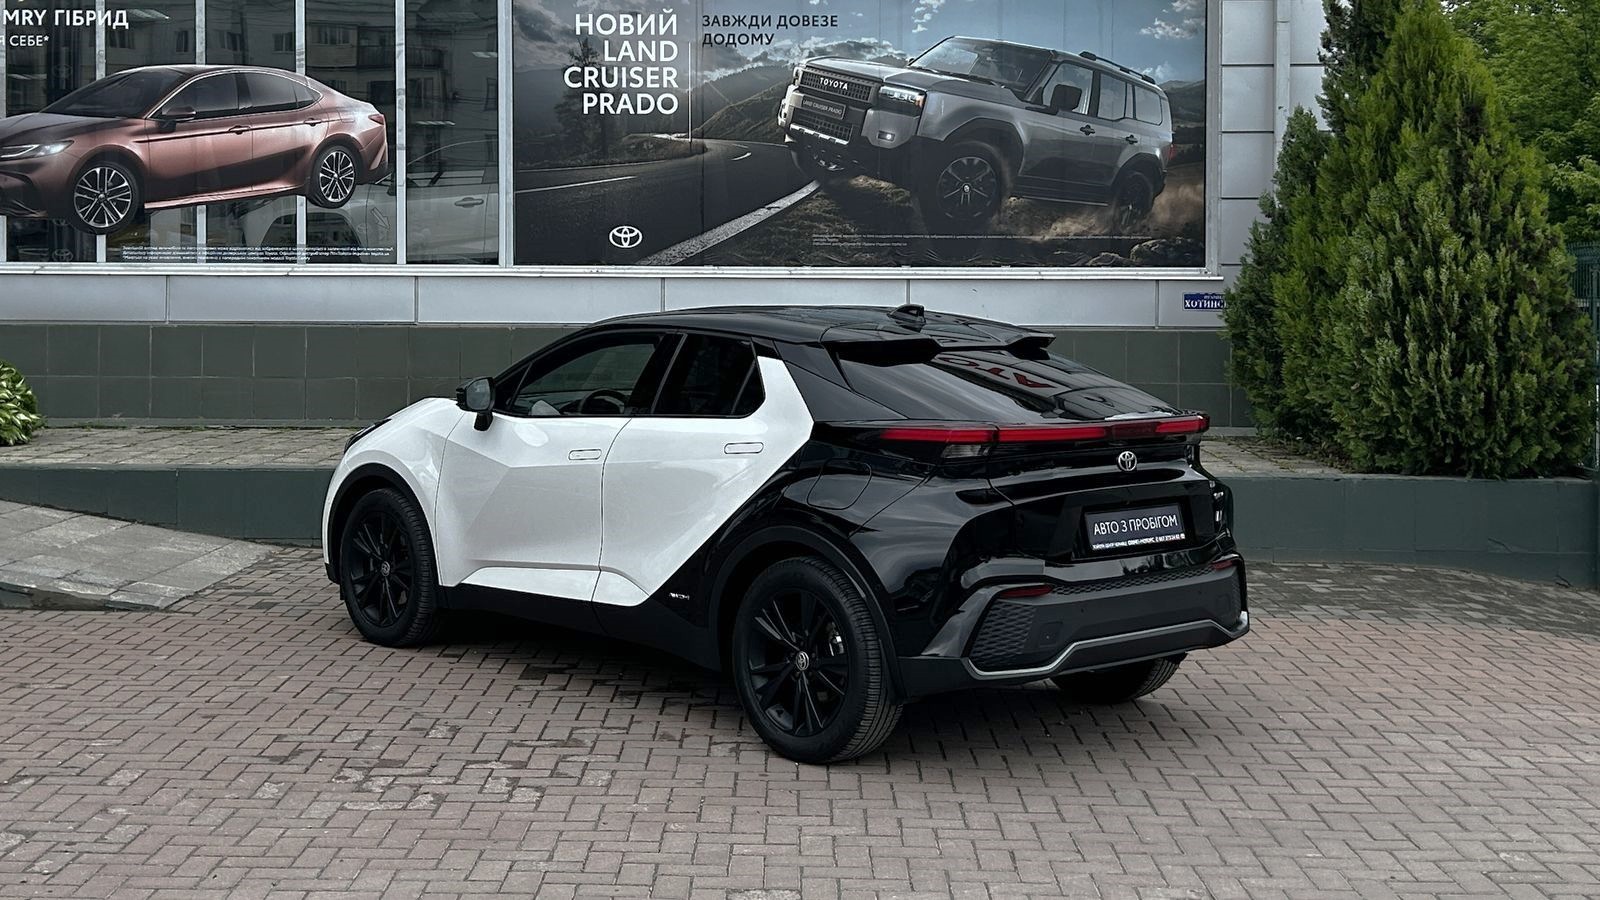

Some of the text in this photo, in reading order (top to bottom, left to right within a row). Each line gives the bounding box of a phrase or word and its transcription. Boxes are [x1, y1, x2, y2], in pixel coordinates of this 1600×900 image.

[3, 9, 129, 30] MRY ГІБРИД
[575, 8, 677, 36] НОВИЙ
[702, 15, 838, 30] ЗАВЖДИ ДОВЕЗЕ
[702, 33, 775, 48] ДОДОМУ
[604, 41, 678, 62] LAND
[563, 66, 678, 88] CRUISER
[820, 77, 848, 90] TOYOTA
[583, 94, 679, 115] PRADO
[1094, 514, 1177, 536] АВТО З ПРОБІГОМ
